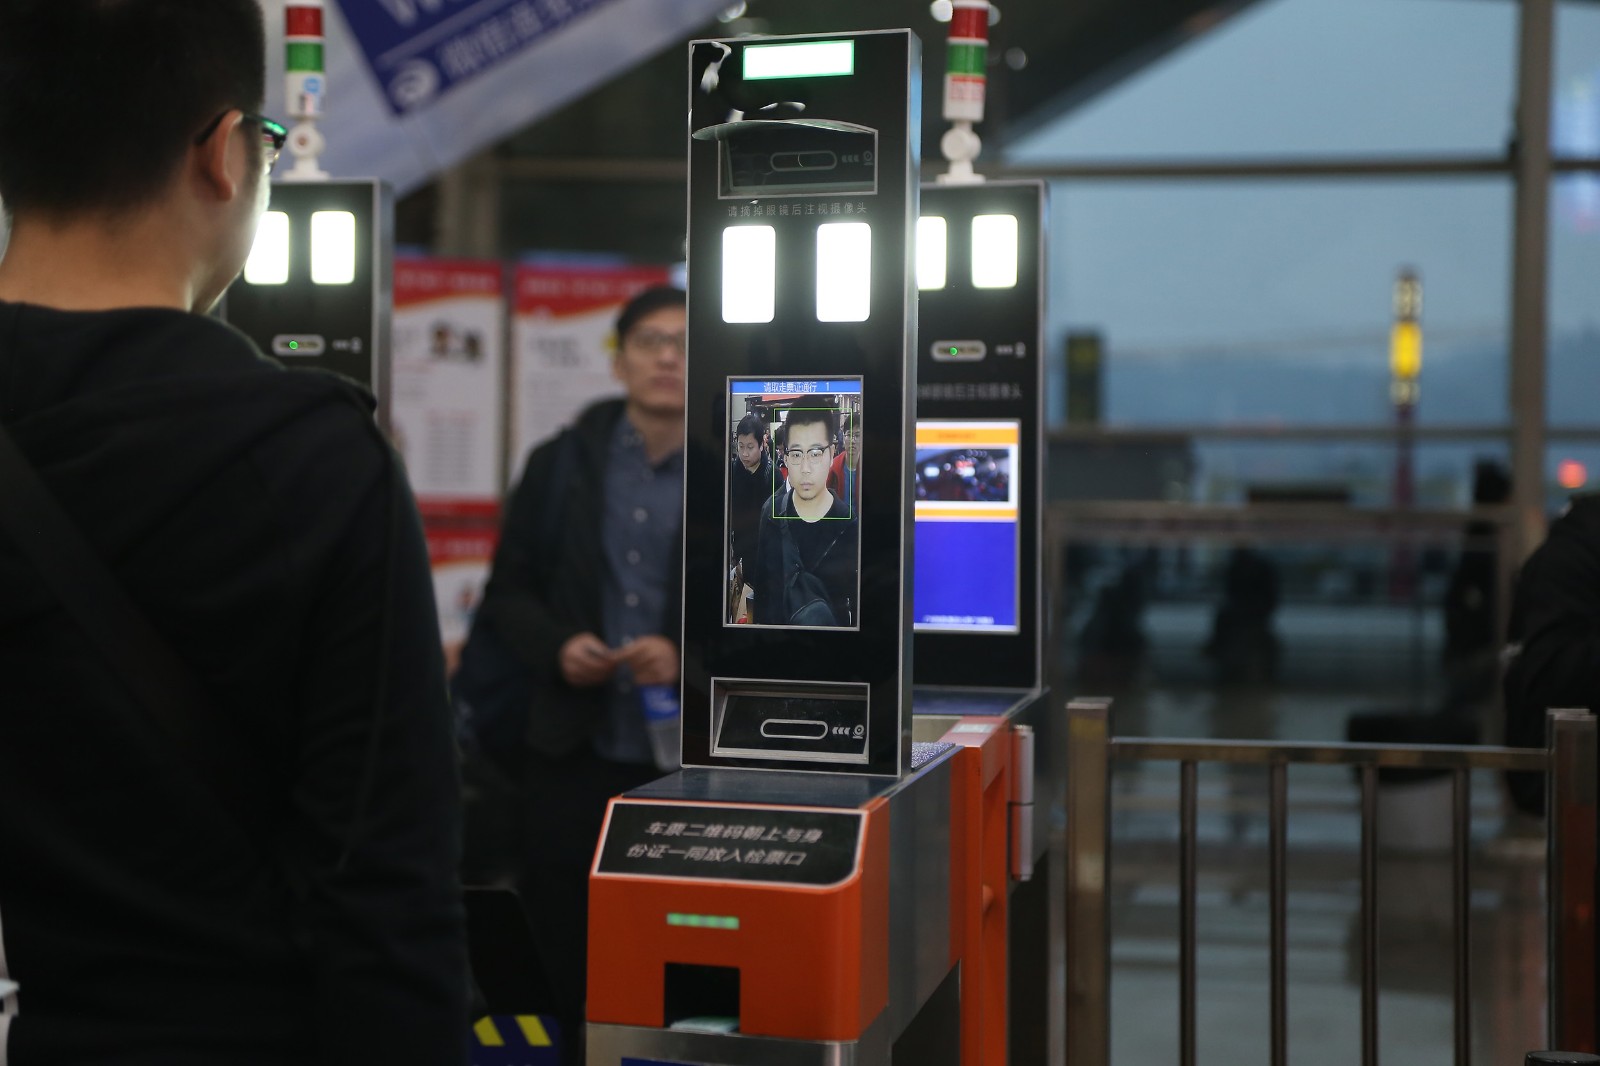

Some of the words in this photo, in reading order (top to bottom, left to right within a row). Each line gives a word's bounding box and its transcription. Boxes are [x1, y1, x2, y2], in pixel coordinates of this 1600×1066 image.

[727, 202, 867, 217] 请摘掉眼镜后注视摄像头
[763, 381, 817, 393] 请取走票证通行
[645, 821, 823, 844] 车票二维码朝上与身
[626, 843, 807, 866] 份证一同放入检票口
